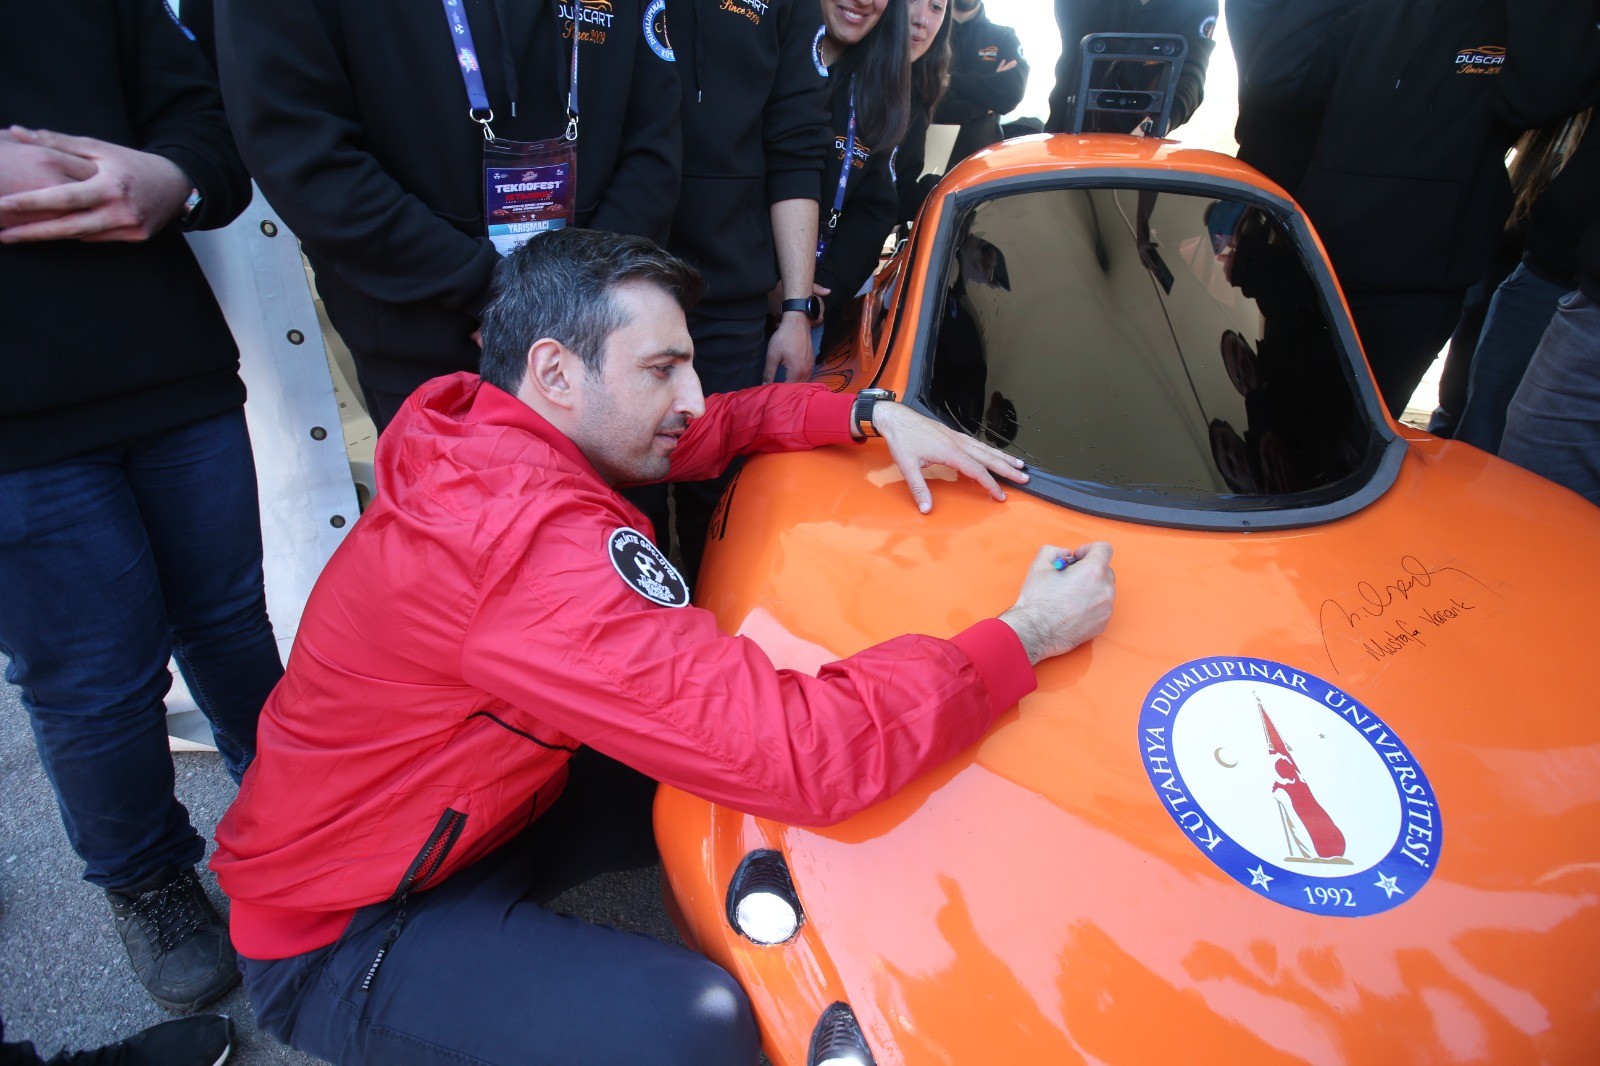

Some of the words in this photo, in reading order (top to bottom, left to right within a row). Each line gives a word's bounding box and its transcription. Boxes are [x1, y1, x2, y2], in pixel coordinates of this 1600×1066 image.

[1456, 64, 1485, 74] Since
[835, 140, 869, 162] DUCART
[495, 180, 564, 194] TEKNOFEST
[1149, 660, 1311, 717] DUMLUPINAR
[1145, 725, 1224, 853] KÜTAHYA
[1323, 688, 1435, 869] ÜNİVERSİTESİ
[1302, 885, 1357, 907] 1992
